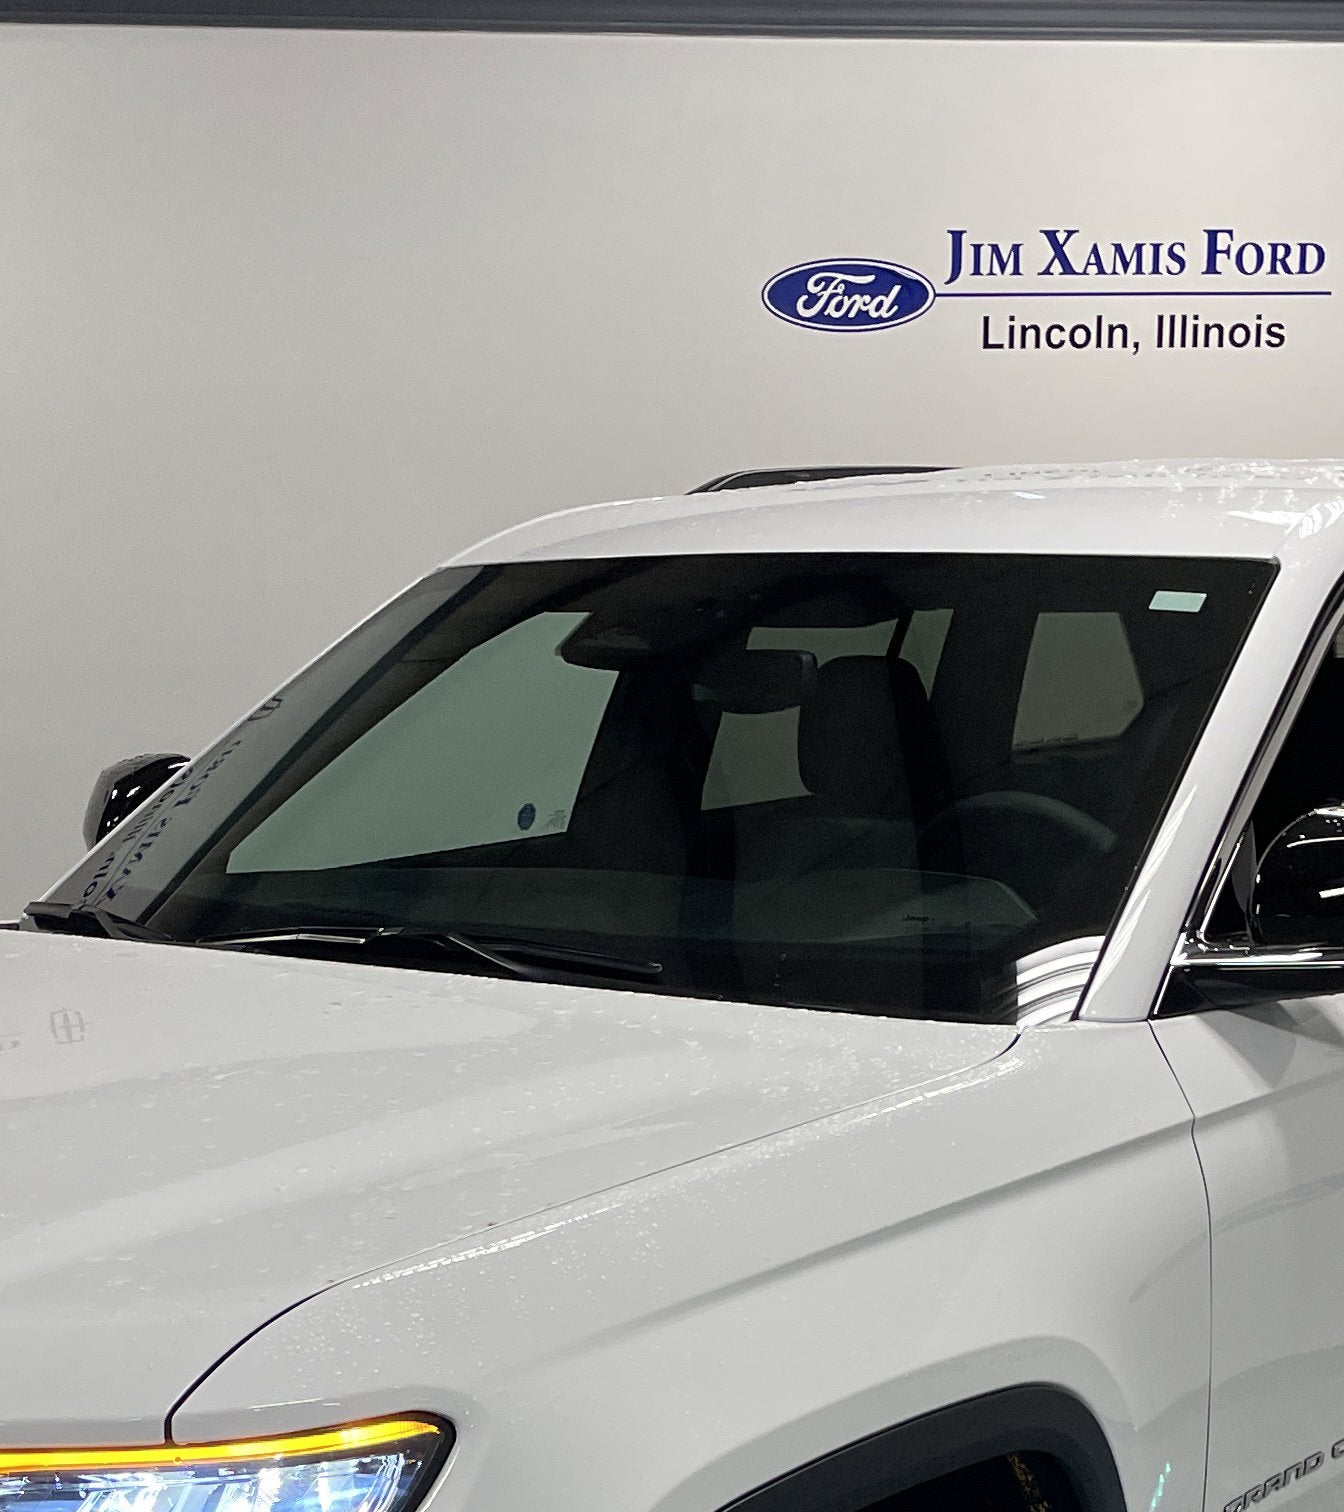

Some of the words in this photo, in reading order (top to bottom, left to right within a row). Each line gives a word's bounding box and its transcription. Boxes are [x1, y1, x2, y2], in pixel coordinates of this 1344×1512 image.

[943, 228, 1023, 286] JIM
[1038, 229, 1186, 277] XAMIS
[1200, 228, 1327, 277] FORD
[796, 271, 900, 320] Ford
[980, 314, 1140, 356] Lincoln,
[1156, 314, 1286, 349] Illinois
